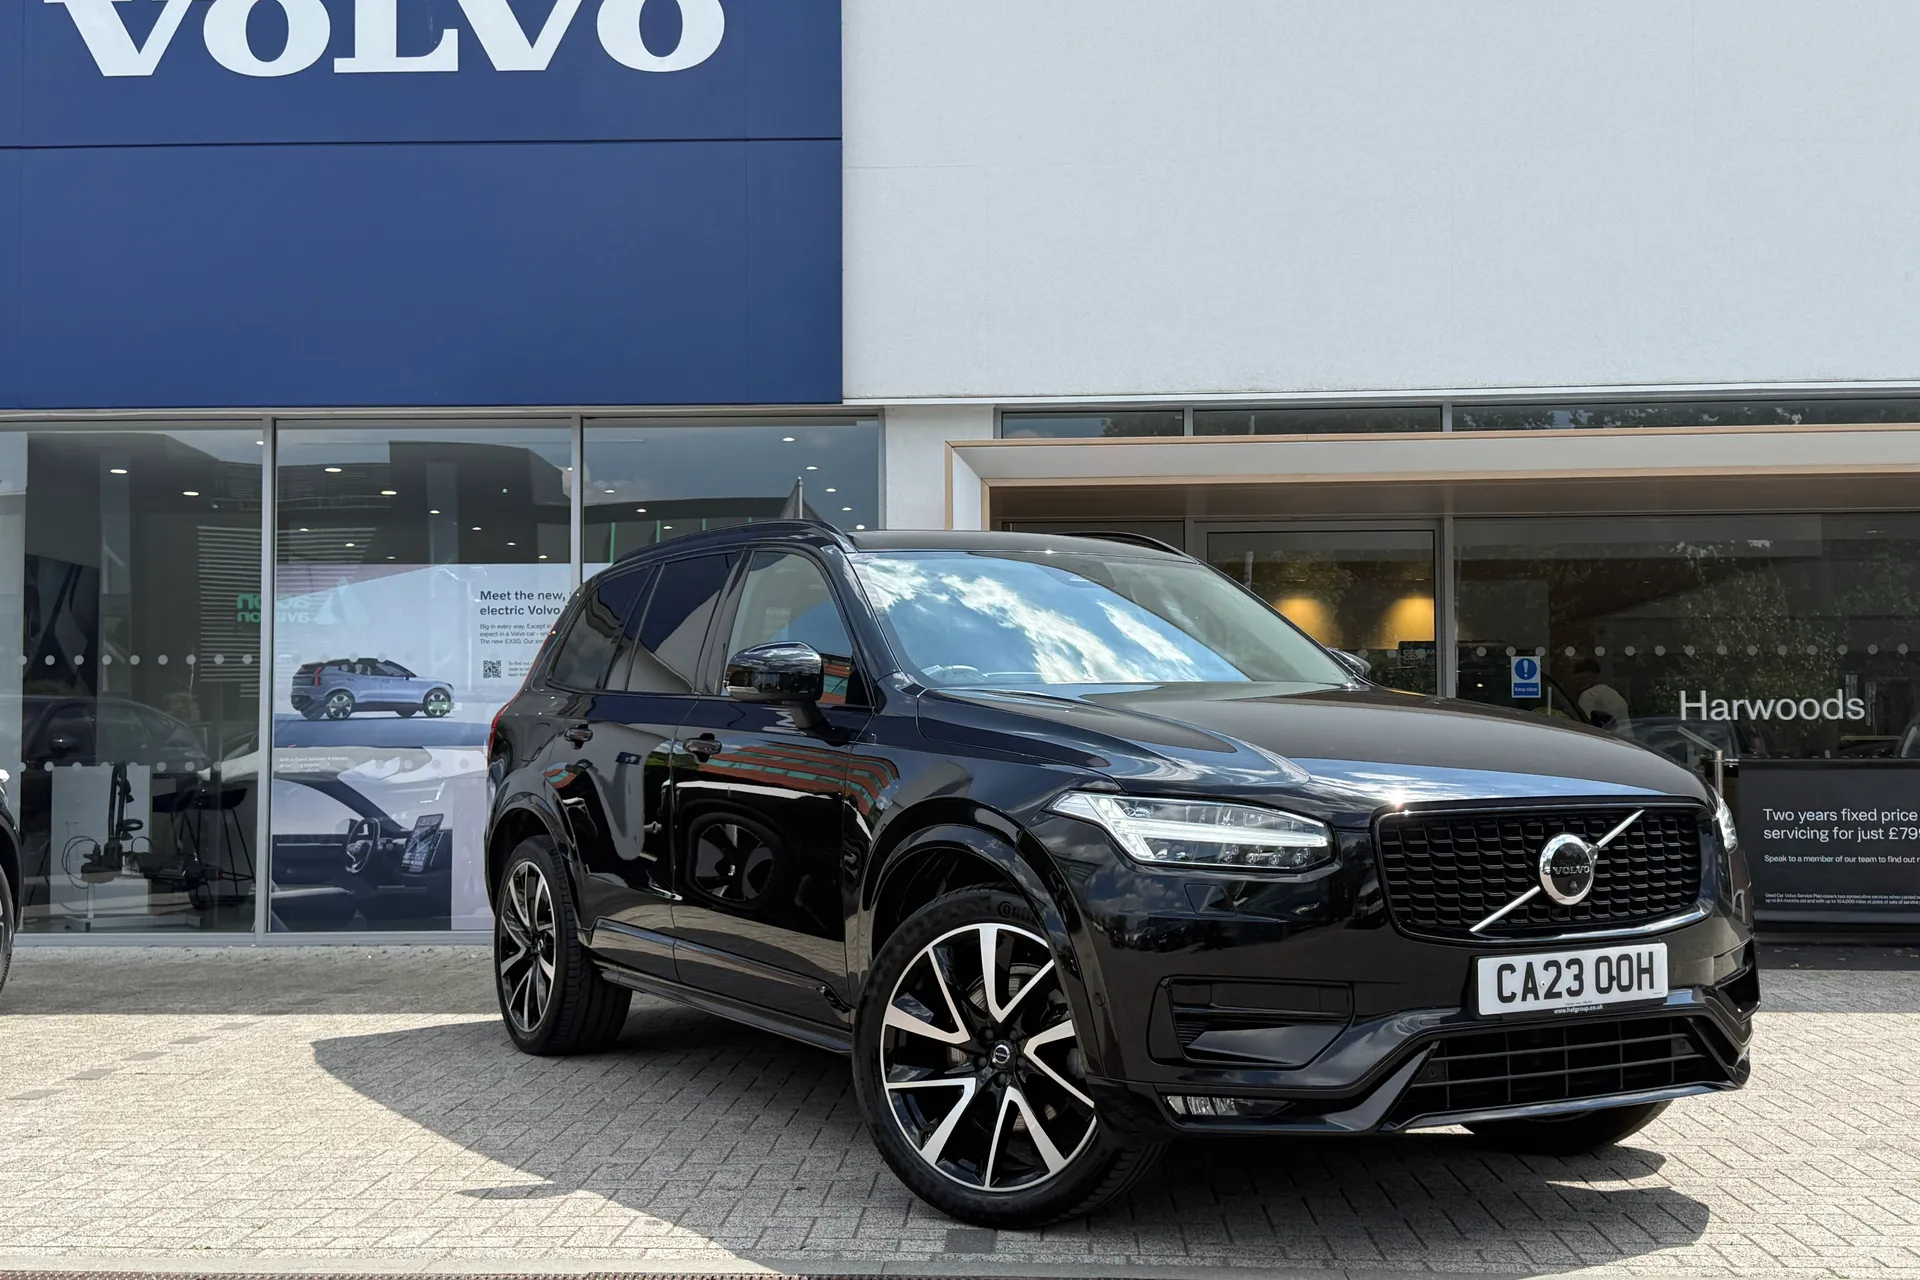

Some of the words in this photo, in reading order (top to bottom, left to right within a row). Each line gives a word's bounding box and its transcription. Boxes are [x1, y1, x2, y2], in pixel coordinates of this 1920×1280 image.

[44, 0, 725, 77] VOLVO
[480, 591, 511, 601] Meet
[515, 590, 534, 601] the
[538, 593, 566, 602] new,
[480, 605, 524, 615] electric
[528, 605, 561, 615] Volvo
[1678, 688, 1866, 721] Harwoods
[1763, 808, 1795, 821] Two
[1798, 810, 1837, 824] years
[1841, 808, 1877, 821] fixed
[1881, 808, 1918, 824] price
[1763, 827, 1829, 843] servicing
[1833, 827, 1854, 840] for
[1857, 827, 1885, 843] just
[1888, 827, 1920, 840] £79
[1764, 855, 1787, 864] Speak
[1788, 855, 1796, 863] to
[1803, 855, 1834, 863] member
[1835, 855, 1843, 863] of
[1887, 855, 1902, 863] find
[1552, 865, 1590, 875] VOLVO
[1496, 958, 1584, 1004] CA23
